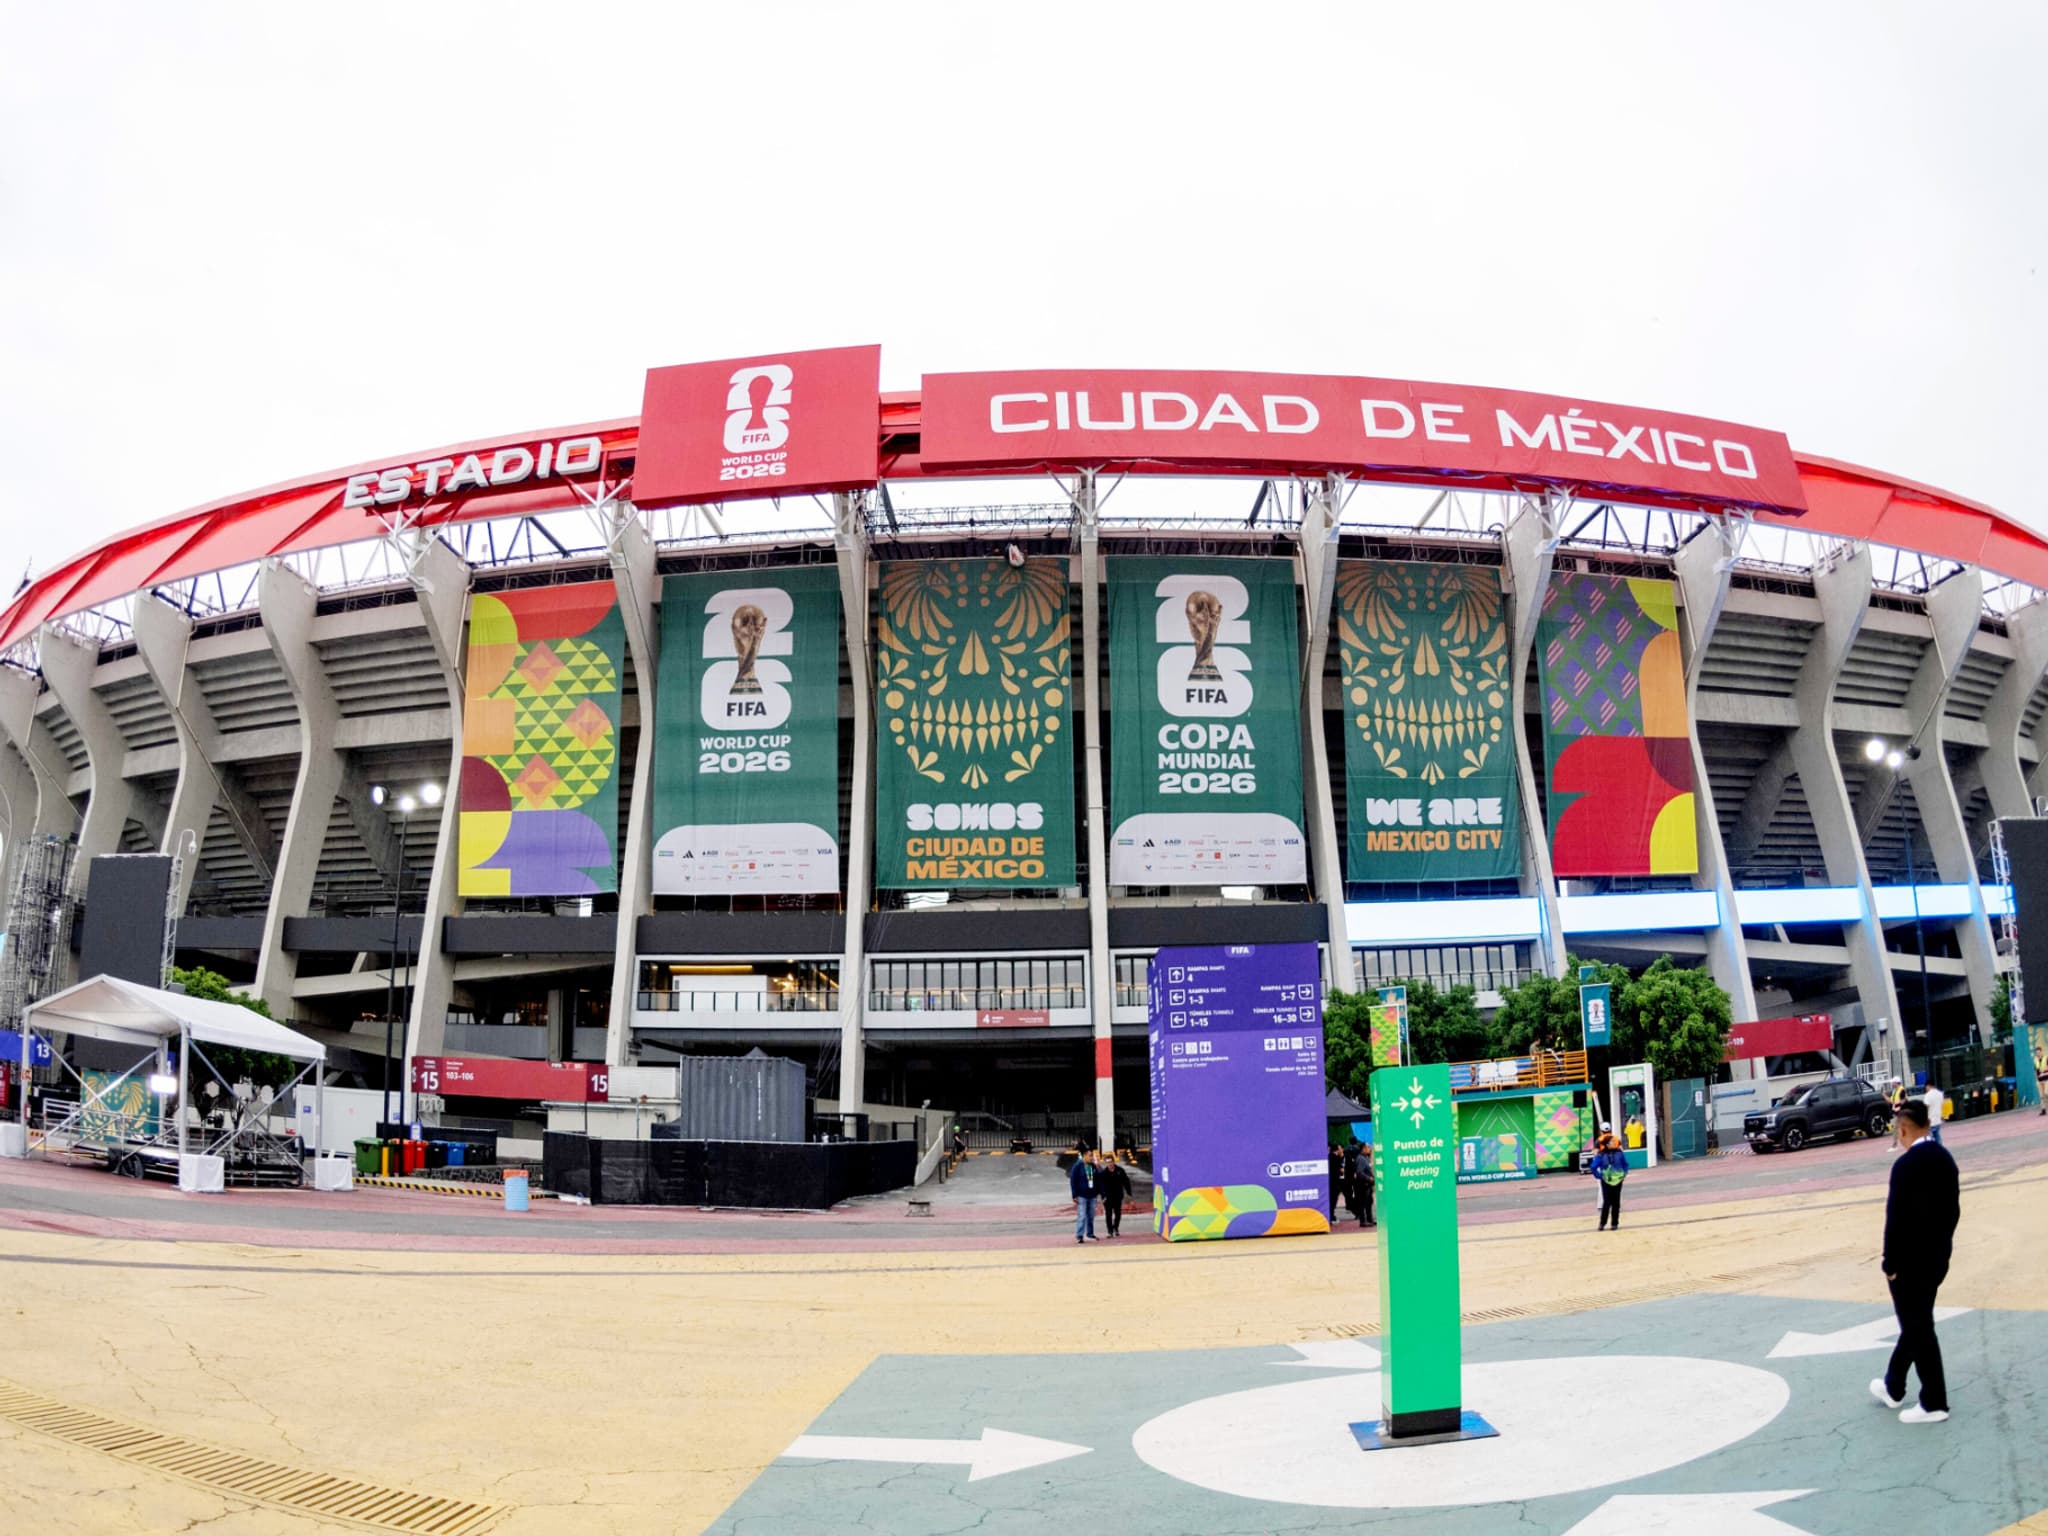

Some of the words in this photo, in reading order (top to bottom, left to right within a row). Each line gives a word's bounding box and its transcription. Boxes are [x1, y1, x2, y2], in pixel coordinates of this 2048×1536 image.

[742, 433, 770, 445] FIFA
[990, 391, 1320, 434] CIUDAD
[1360, 399, 1471, 443] DE
[1495, 408, 1758, 480] MÉXICO
[722, 454, 762, 466] WORLD
[764, 452, 787, 463] CUP
[343, 436, 602, 510] ESTADIO
[719, 462, 787, 480] 2026
[1185, 688, 1228, 703] FIFA
[726, 701, 767, 717] FIFA
[700, 736, 756, 750] WORLD
[759, 734, 791, 747] CUP
[1158, 723, 1255, 750] COPA
[699, 750, 792, 774] 2026
[1158, 753, 1256, 769] MUNDIAL
[1158, 772, 1257, 794] 2026
[906, 803, 1044, 831] SOMOS
[1366, 798, 1423, 826] WE
[906, 837, 1006, 857] CIUDAD
[1011, 837, 1045, 856] DE
[1367, 830, 1450, 851] MEXICO
[1456, 829, 1502, 850] CITY
[816, 848, 833, 856] VISA
[906, 856, 1045, 880] MÉXICO
[1231, 946, 1249, 954] FIFA
[1187, 973, 1194, 982] 4
[36, 1043, 50, 1058] 13
[421, 1071, 439, 1090] 15
[591, 1073, 608, 1092] 15
[1393, 1140, 1427, 1150] Punto
[1429, 1137, 1443, 1147] de
[1398, 1151, 1440, 1164] reunión
[1400, 1165, 1440, 1177] Meeting
[1407, 1179, 1434, 1190] Point
